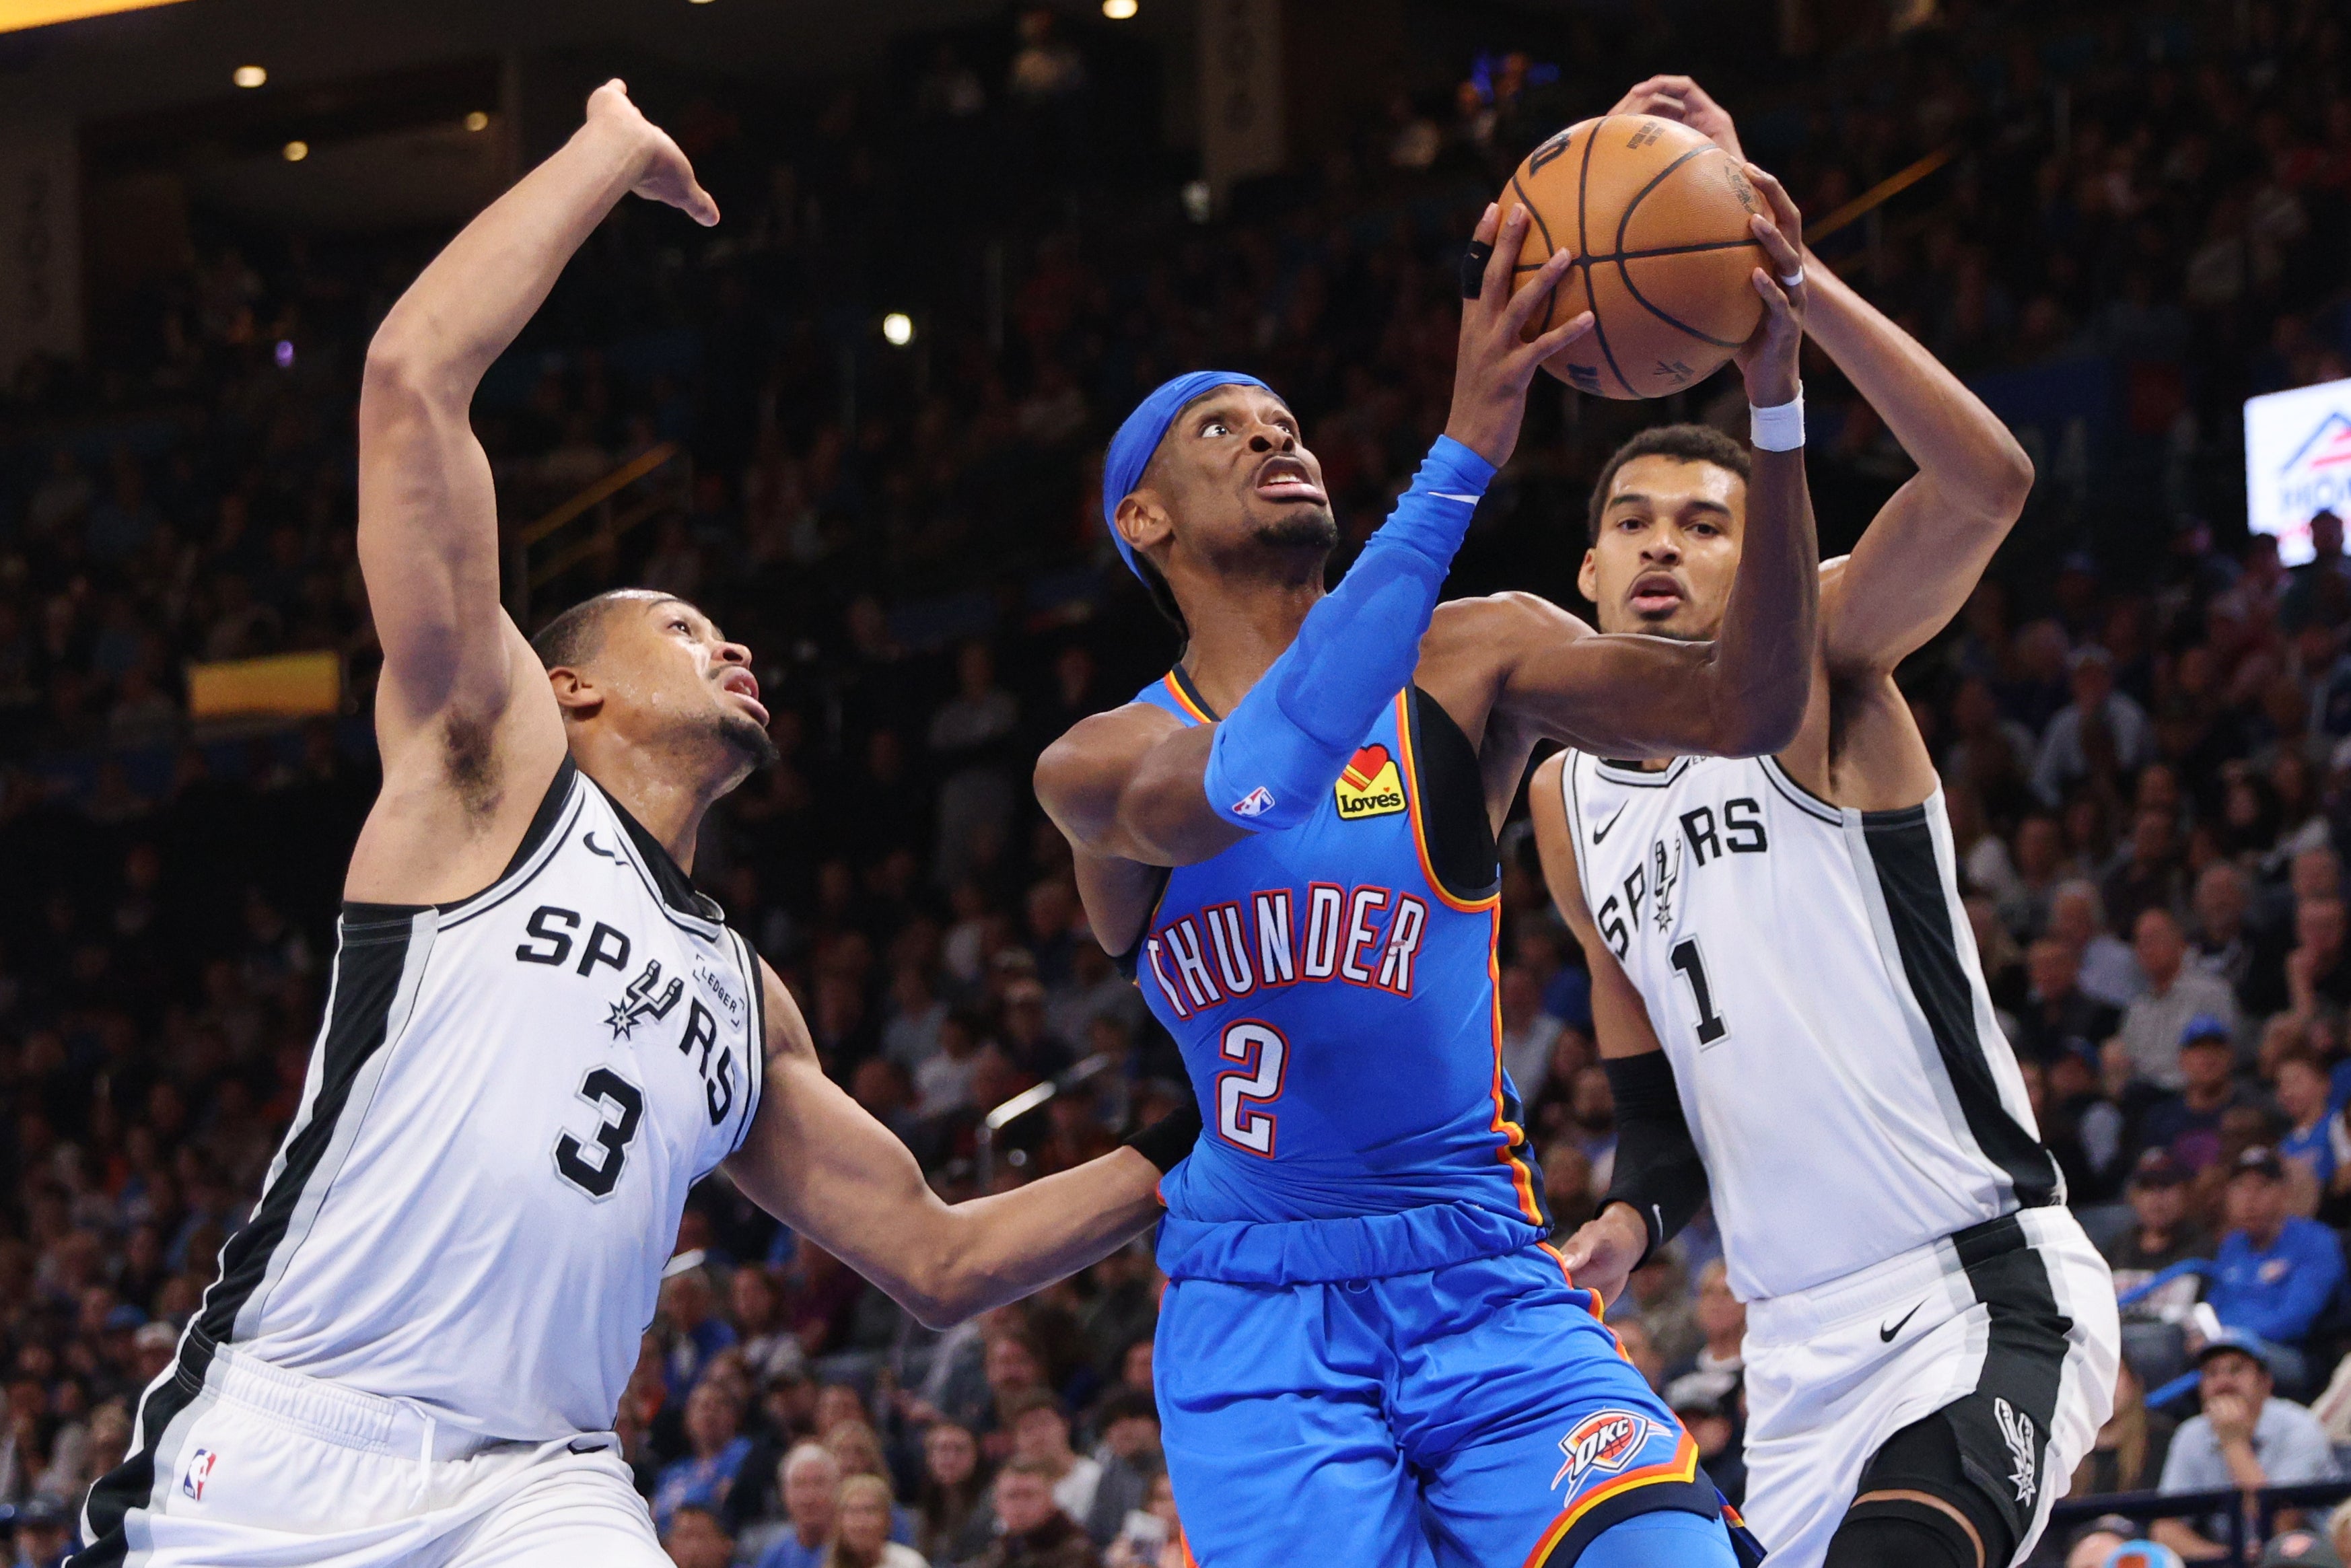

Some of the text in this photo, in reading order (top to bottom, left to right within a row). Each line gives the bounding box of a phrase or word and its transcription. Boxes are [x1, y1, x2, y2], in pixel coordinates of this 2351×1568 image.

[1598, 797, 1767, 963] SPURS
[516, 905, 737, 1126] SPURS
[701, 965, 737, 1014] LEDGER
[1146, 881, 1430, 1021] THUNDER
[1666, 932, 1730, 1053] 1
[549, 1063, 645, 1205] 3
[1216, 1018, 1290, 1160] 2
[1573, 1418, 1629, 1480] OKC
